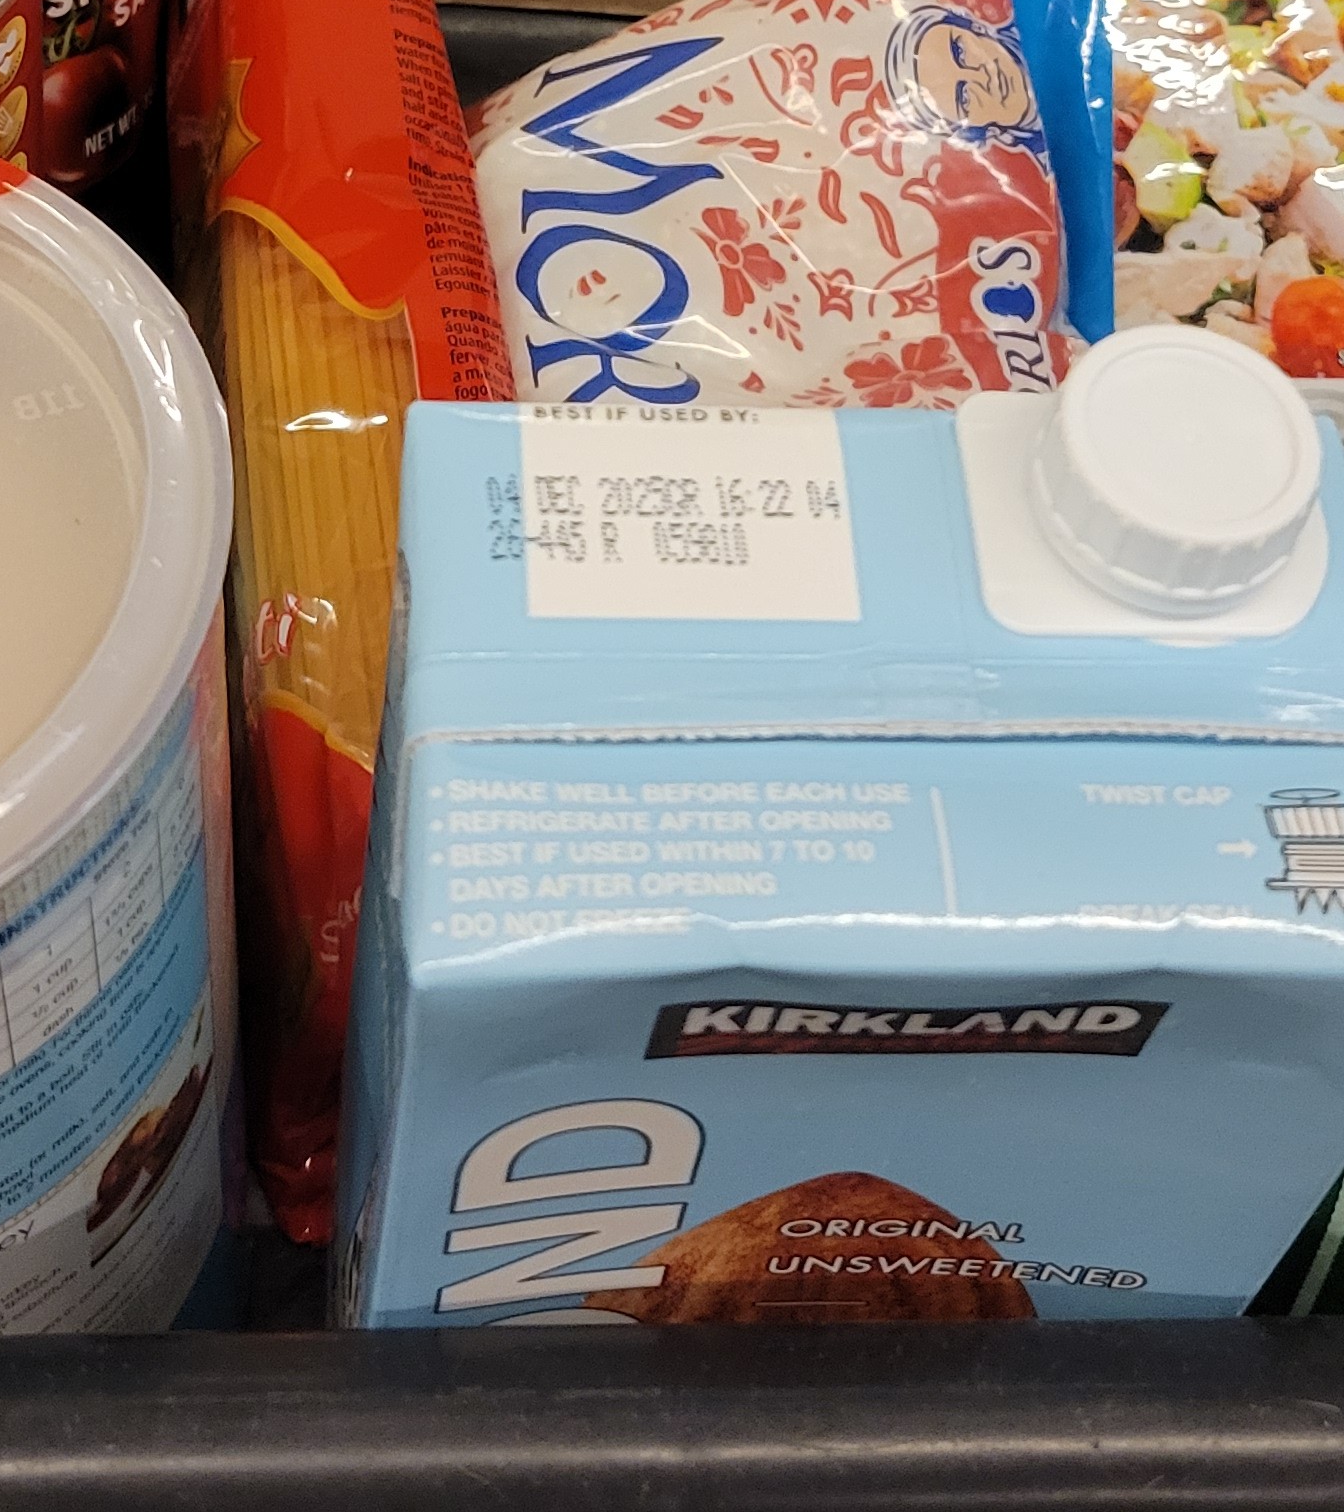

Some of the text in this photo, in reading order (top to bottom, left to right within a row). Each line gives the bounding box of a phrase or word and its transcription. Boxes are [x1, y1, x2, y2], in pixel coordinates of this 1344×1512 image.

[85, 121, 115, 157] NET
[427, 238, 445, 250] de
[445, 321, 480, 336] água
[455, 385, 489, 403] fogo
[535, 406, 761, 424] BEST IF USED BY:
[534, 475, 584, 516] DEC
[447, 779, 912, 804] SHAKE WELL BEFORE EACH USE
[1080, 783, 1233, 807] TWIST CAP
[450, 810, 893, 834] REFRIGERATE AFTER OPENING
[450, 840, 524, 867] BEST
[569, 840, 651, 865] USED
[659, 840, 763, 864] WITHIN
[769, 841, 786, 863] 7
[793, 840, 835, 863] TO
[844, 840, 876, 863] 10
[450, 871, 779, 903] DAYS AFTER OPENING
[450, 912, 496, 938] DO
[503, 910, 567, 937] NOT
[682, 1004, 1143, 1037] KIRKLAND
[437, 1097, 706, 1325] ND
[779, 1219, 1025, 1245] ORIGINAL
[767, 1255, 1149, 1291] UNSWEETENED
